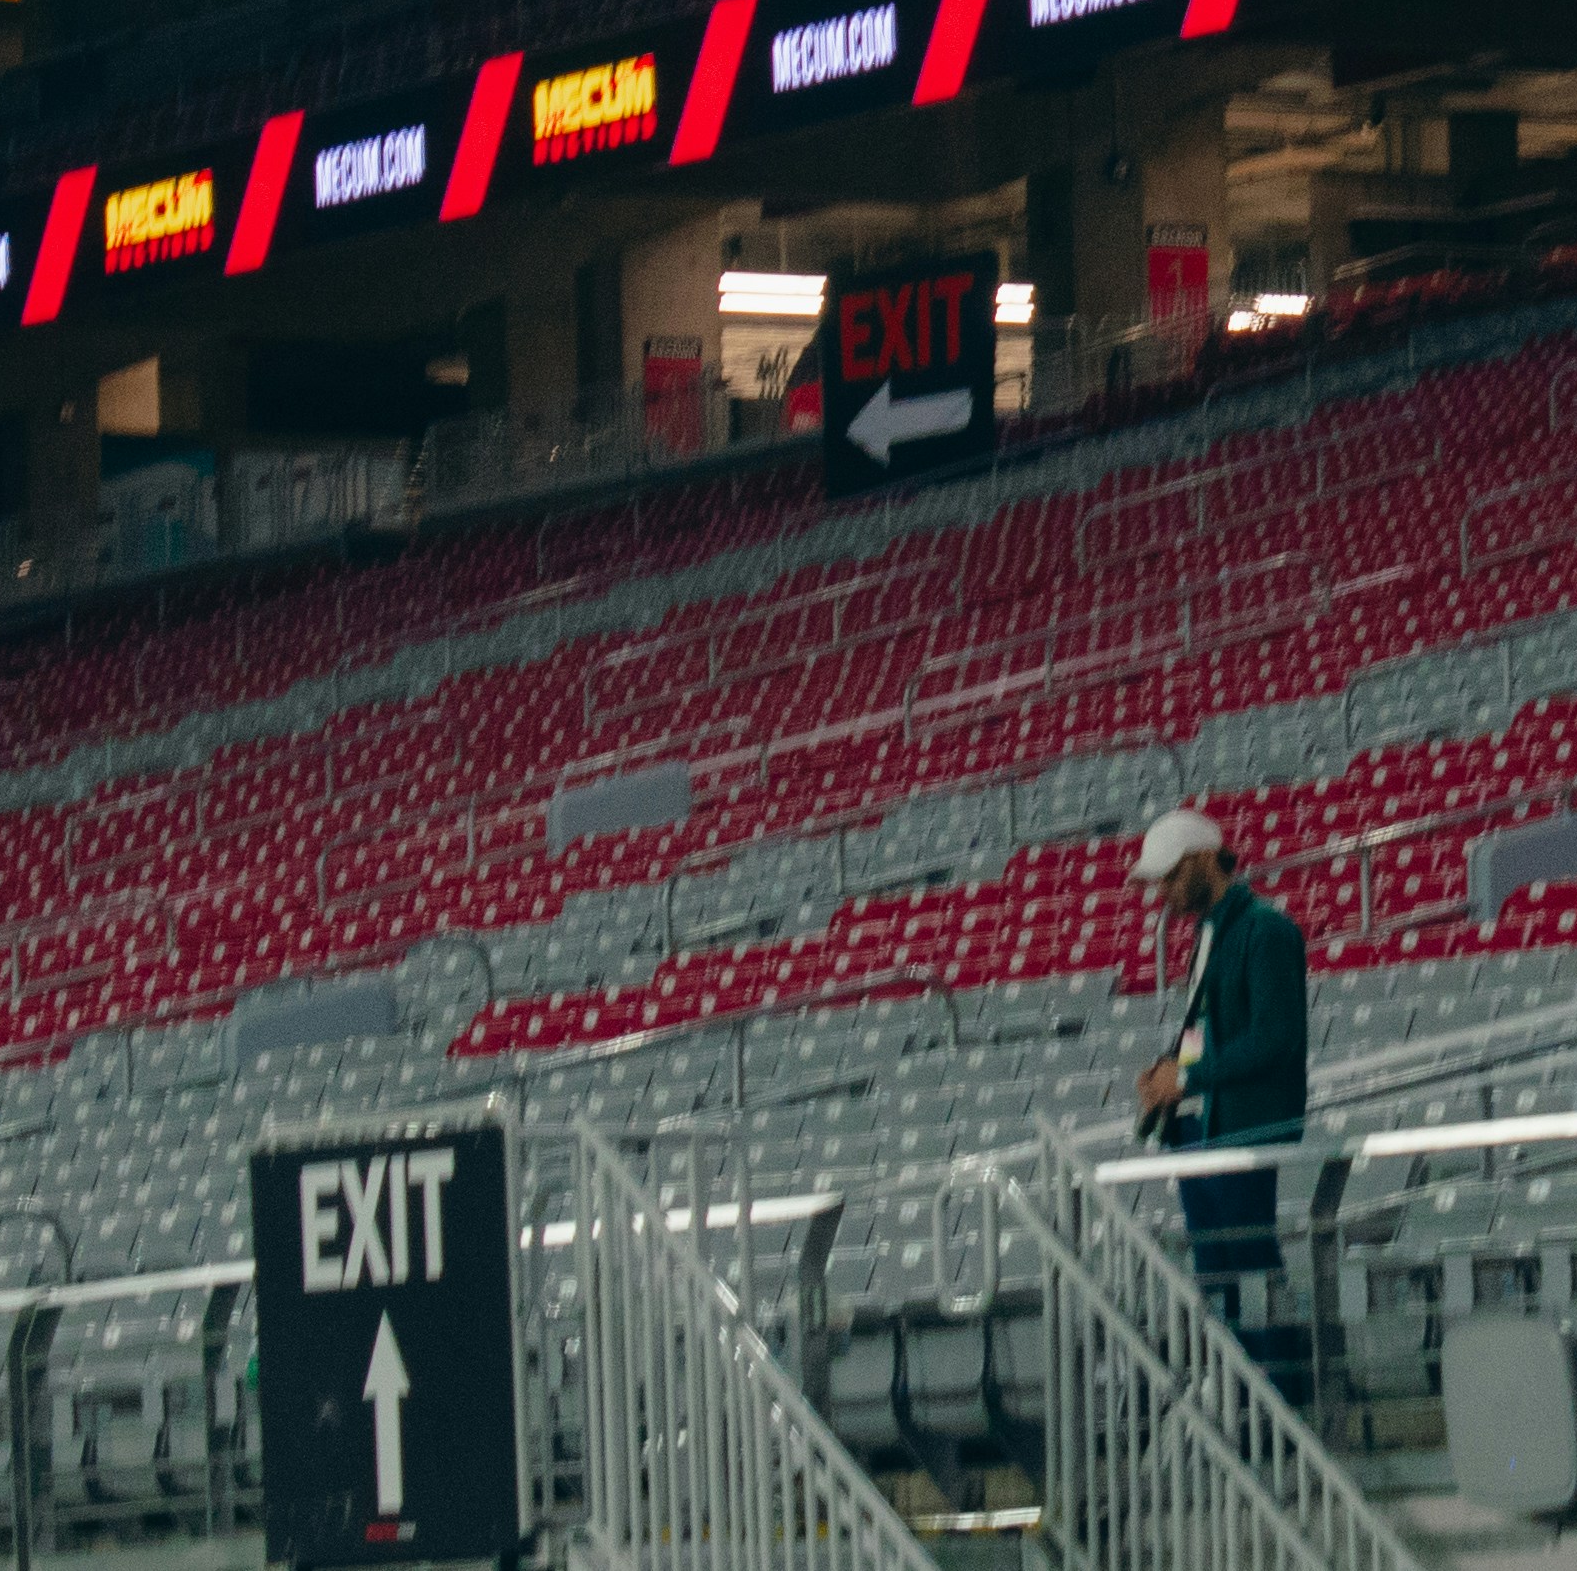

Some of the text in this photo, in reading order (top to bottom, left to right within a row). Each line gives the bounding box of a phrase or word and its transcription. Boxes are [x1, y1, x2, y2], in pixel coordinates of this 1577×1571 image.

[772, 3, 897, 93] MECUM.COM
[533, 54, 656, 140] MECUM
[314, 124, 426, 207] MECUM.COM
[839, 270, 976, 383] EXIT
[300, 1147, 456, 1295] EXIT
